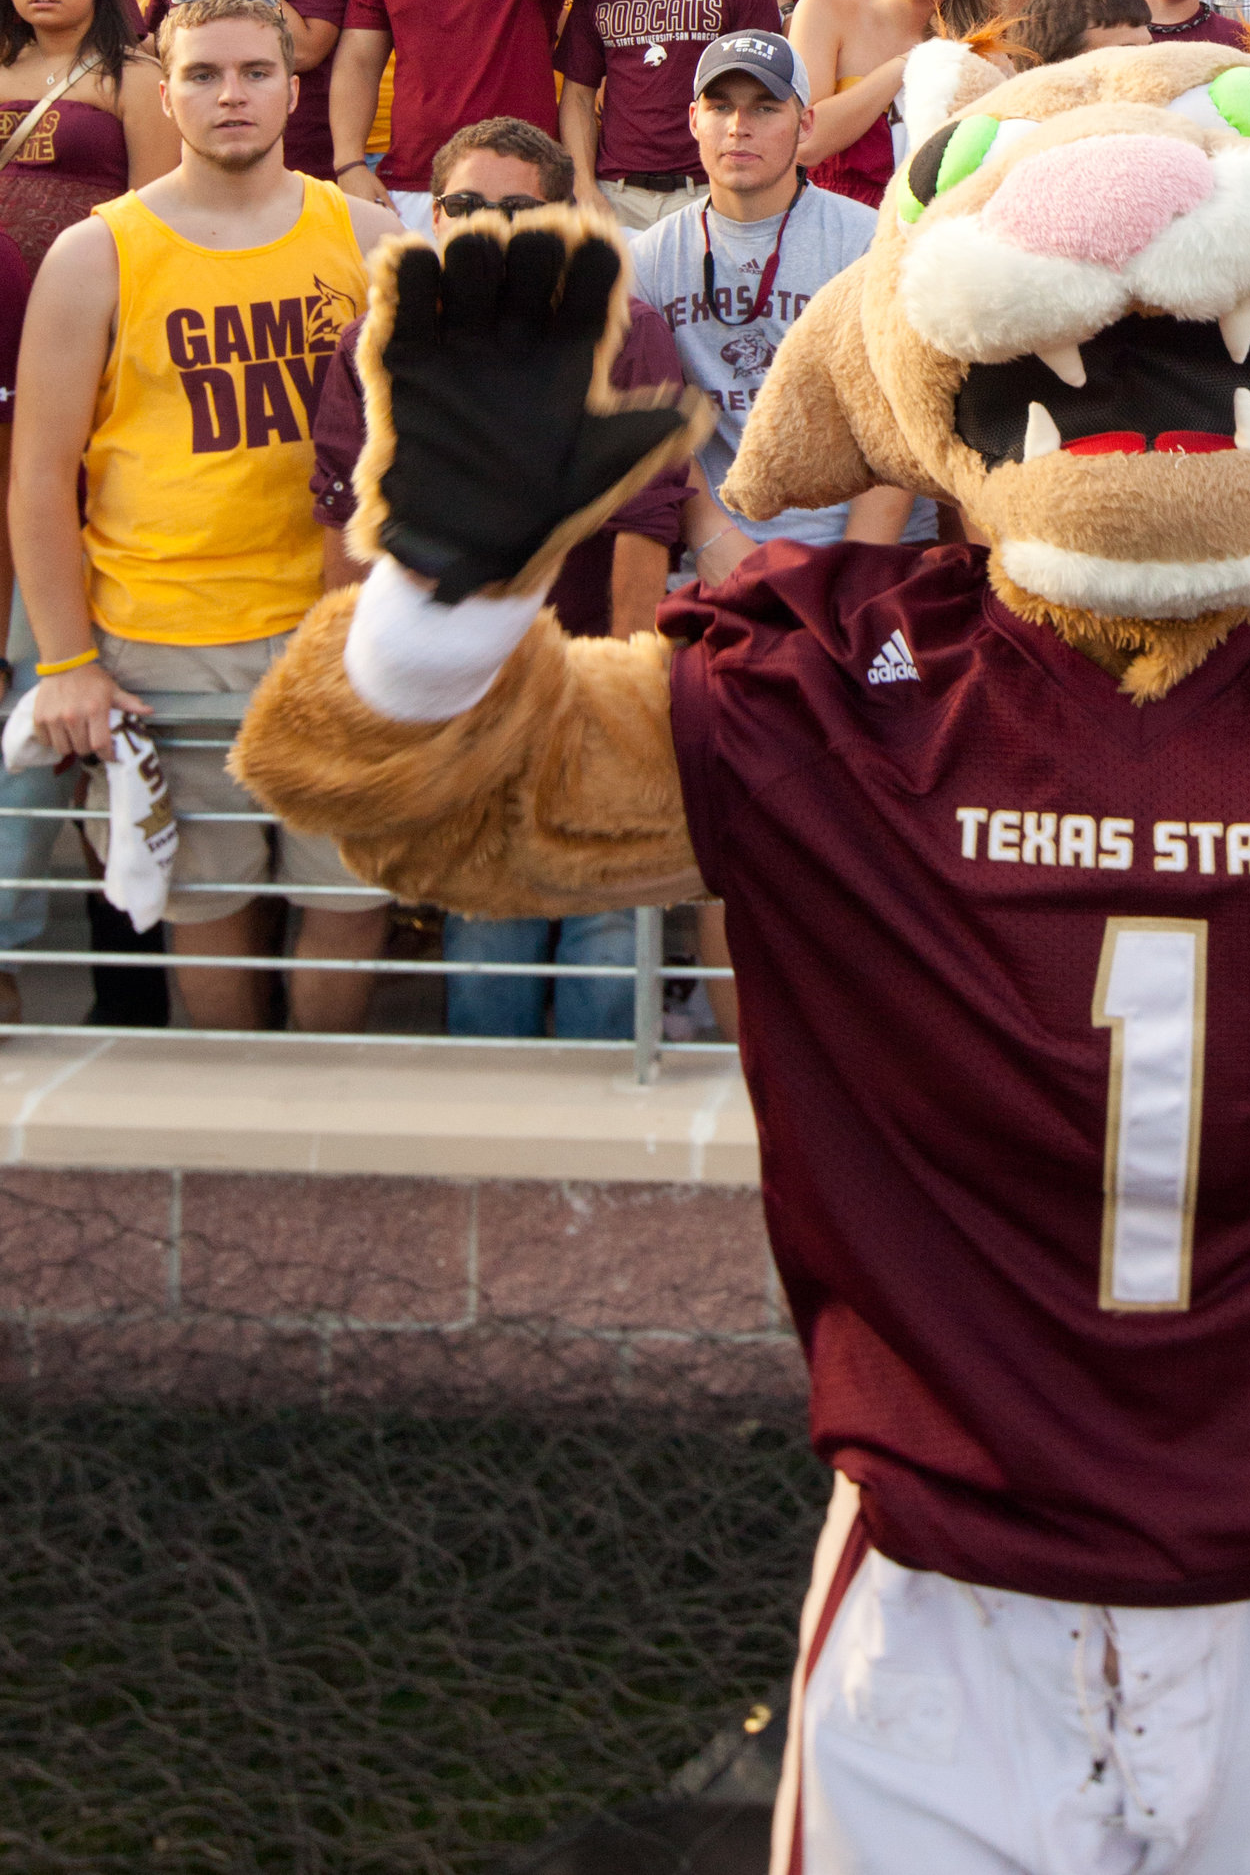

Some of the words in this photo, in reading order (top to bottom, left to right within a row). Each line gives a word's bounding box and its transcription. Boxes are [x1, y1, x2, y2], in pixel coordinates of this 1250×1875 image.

[616, 36, 634, 47] STATE
[691, 31, 720, 42] MARCOS
[721, 37, 775, 56] YETI
[736, 46, 773, 60] COOLERS
[165, 290, 342, 371] GAME
[180, 355, 336, 455] DAY
[868, 662, 922, 685] adida
[956, 807, 1135, 871] TEXAS
[1091, 916, 1209, 1313] 1
